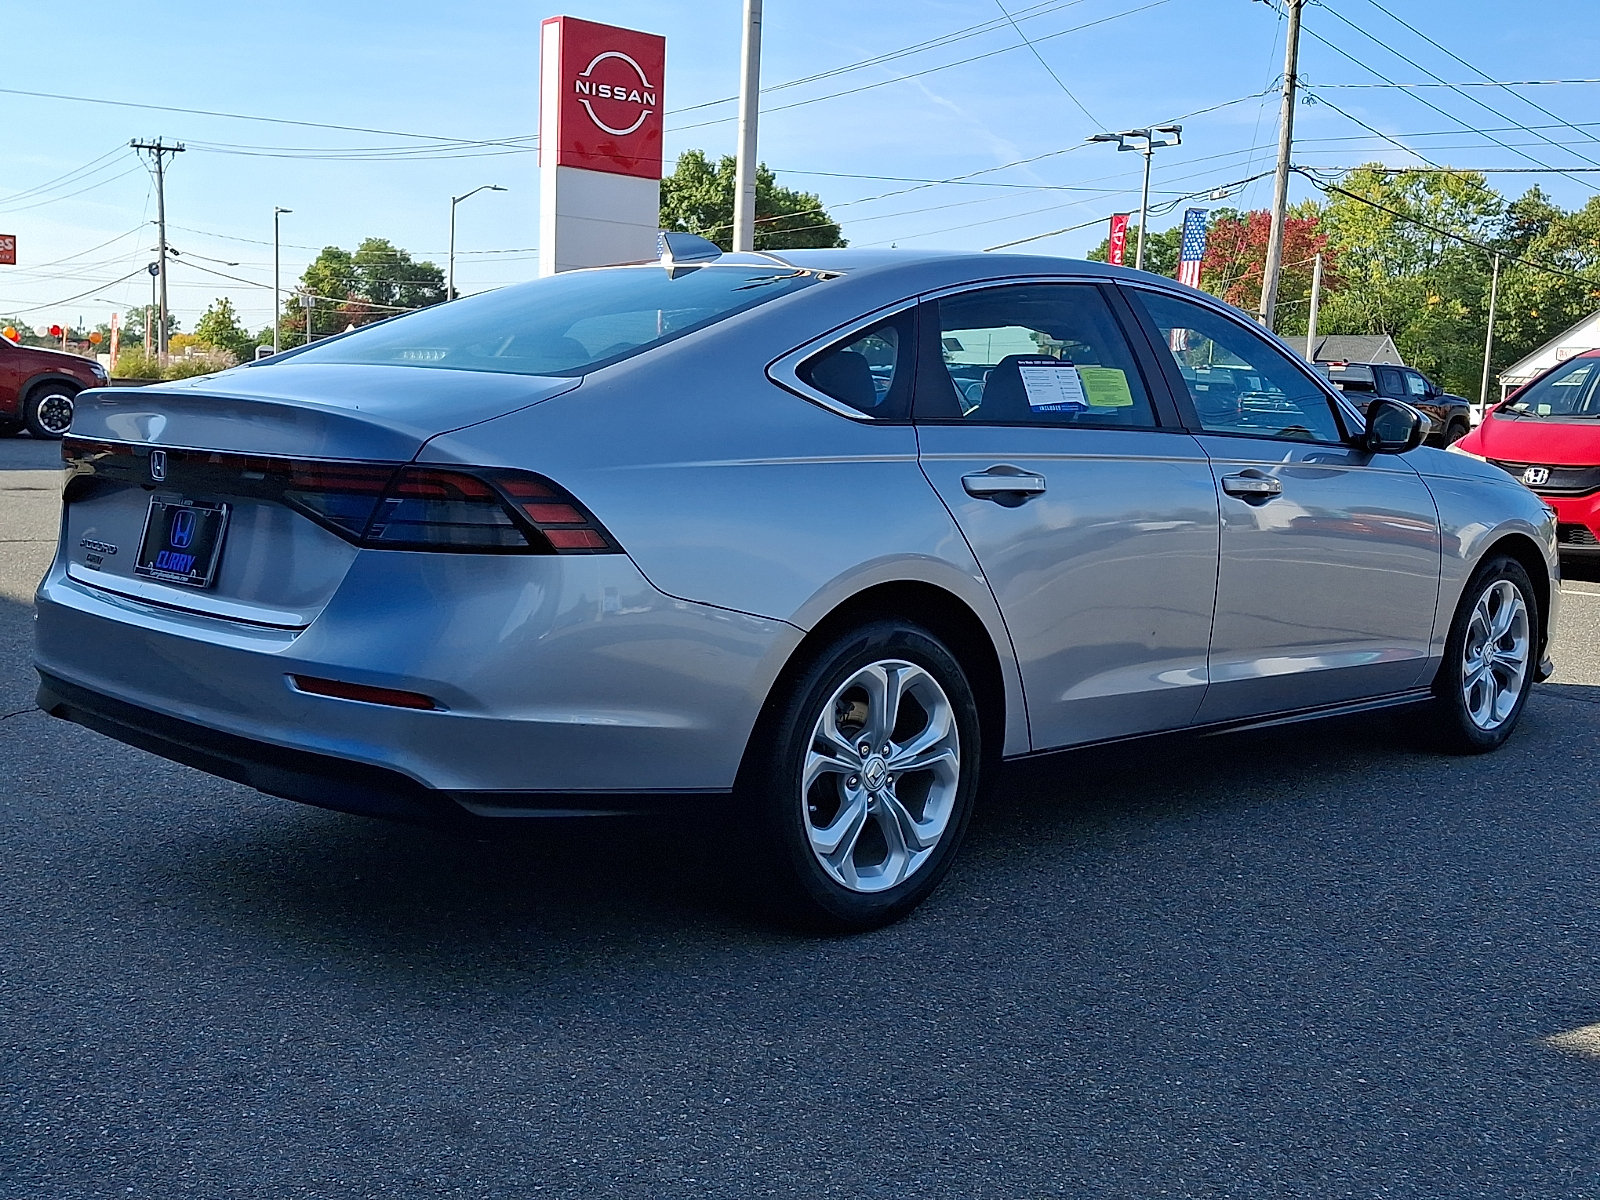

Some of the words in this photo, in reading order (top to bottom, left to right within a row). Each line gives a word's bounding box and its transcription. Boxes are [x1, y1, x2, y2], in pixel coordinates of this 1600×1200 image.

[575, 80, 656, 106] NISSAN
[80, 538, 118, 555] ACCORD
[155, 550, 196, 573] CURRY
